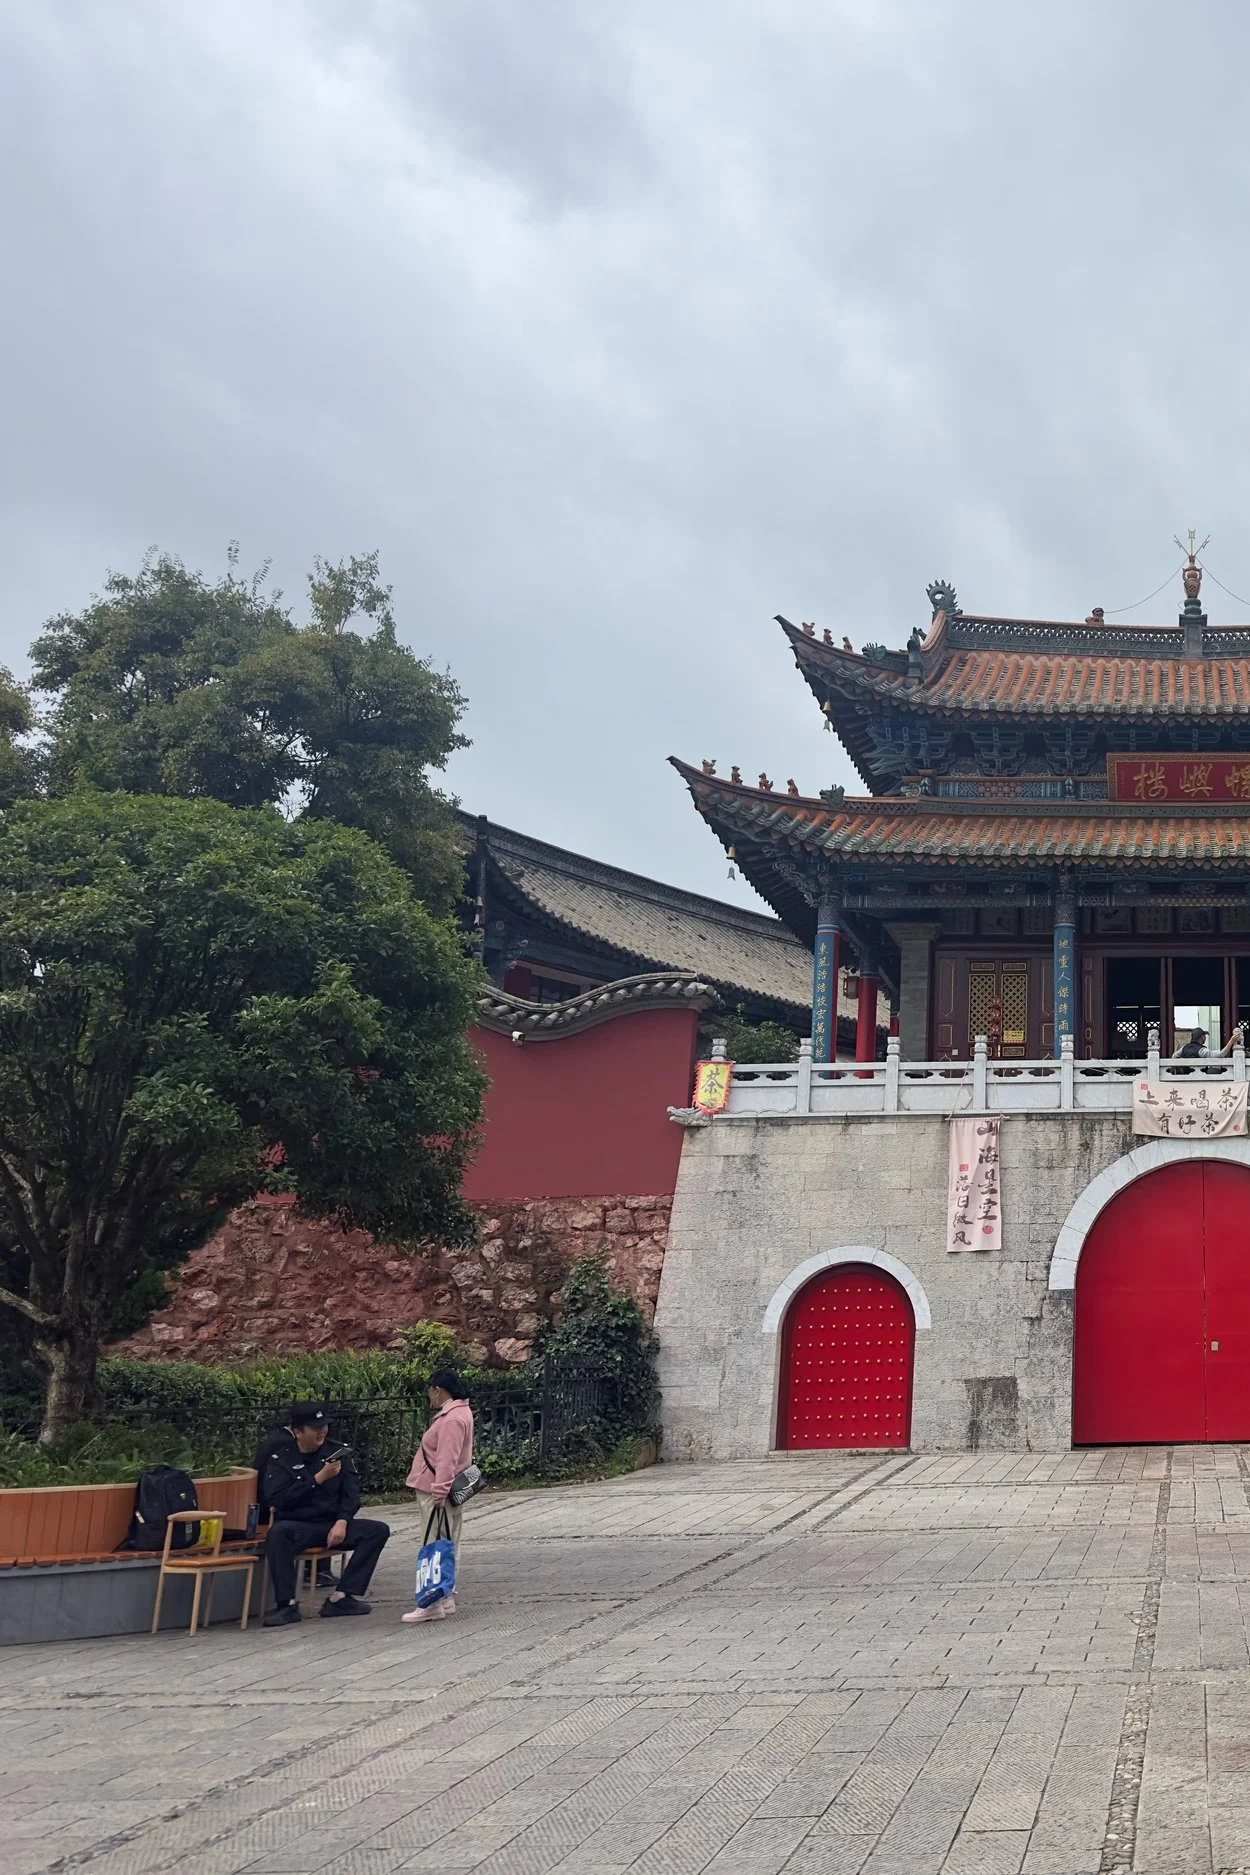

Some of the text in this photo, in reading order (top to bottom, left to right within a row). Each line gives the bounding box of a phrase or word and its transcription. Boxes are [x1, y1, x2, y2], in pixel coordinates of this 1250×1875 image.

[700, 1067, 725, 1094] 茶
[1138, 1087, 1238, 1111] 上来喝茶
[1156, 1112, 1220, 1135] 有好茶
[976, 1120, 999, 1220] 山海星空
